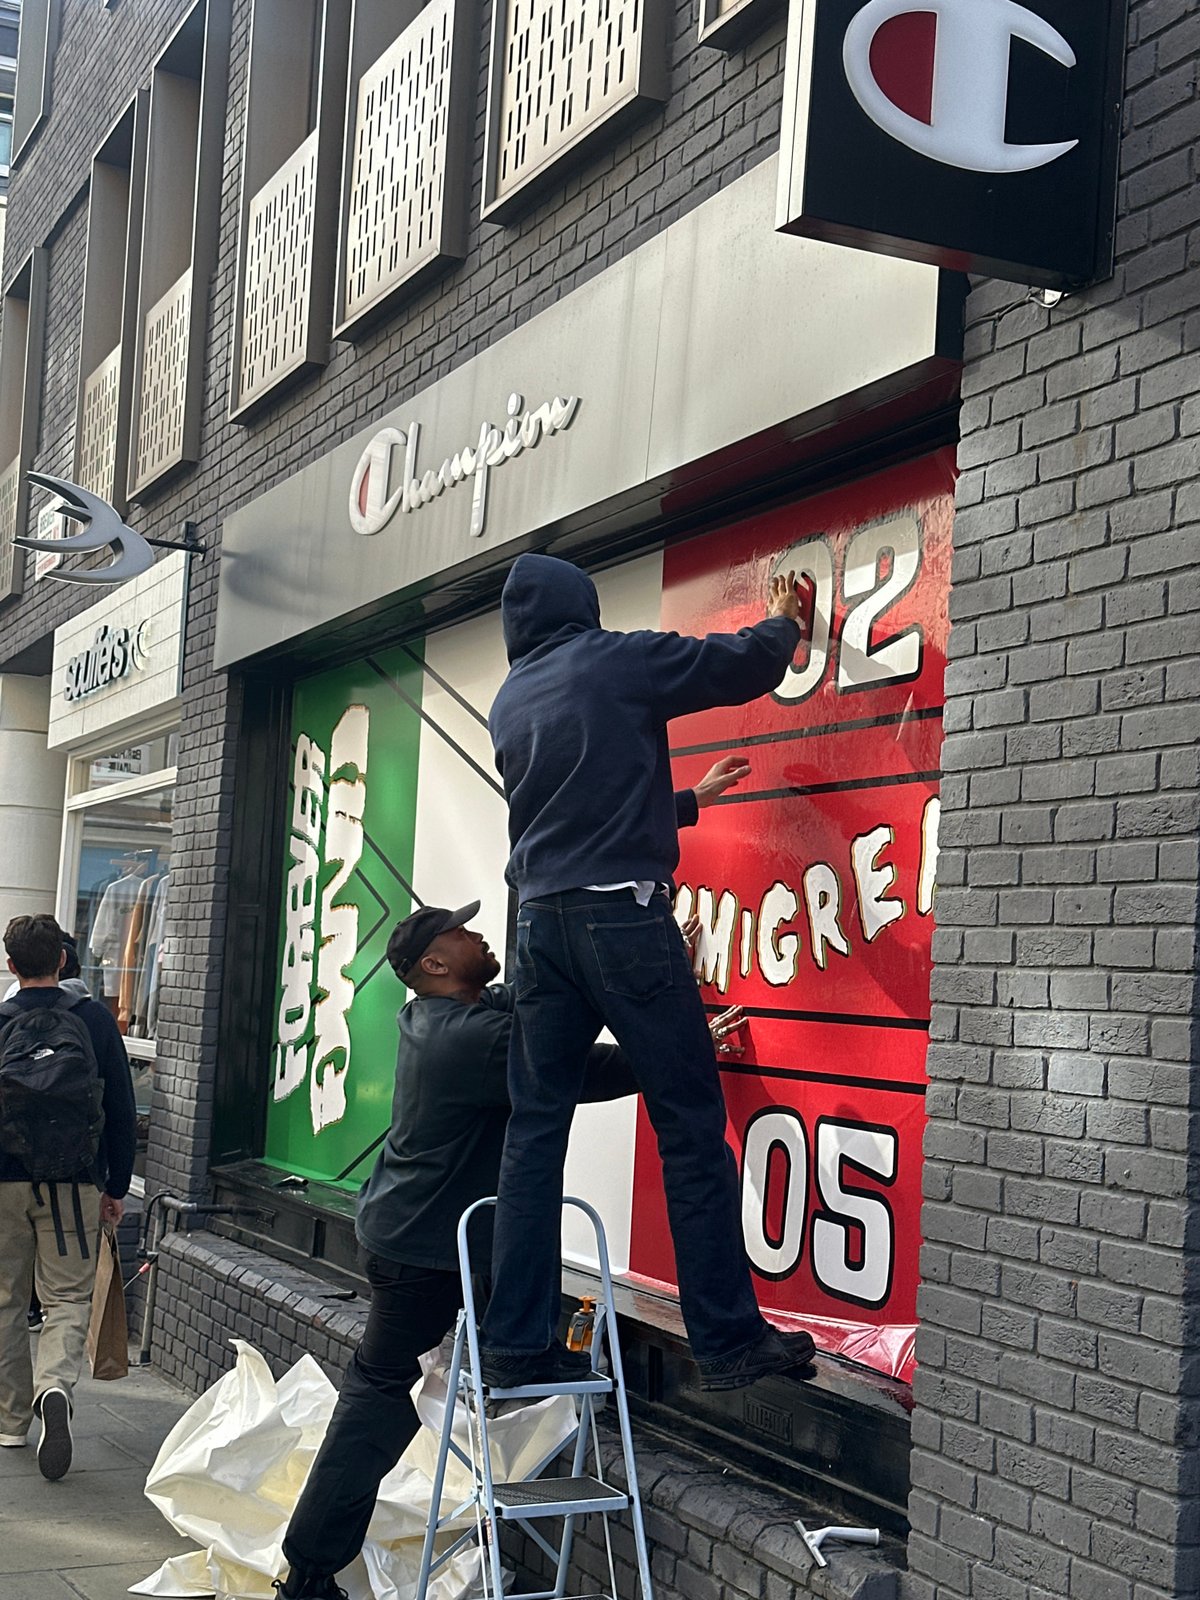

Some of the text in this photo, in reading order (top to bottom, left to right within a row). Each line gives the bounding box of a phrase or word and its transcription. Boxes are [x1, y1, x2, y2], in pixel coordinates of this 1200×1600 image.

[349, 392, 579, 537] Champion
[769, 508, 923, 705] 02
[273, 732, 326, 1104] FOREVER
[741, 1105, 899, 1310] 05
